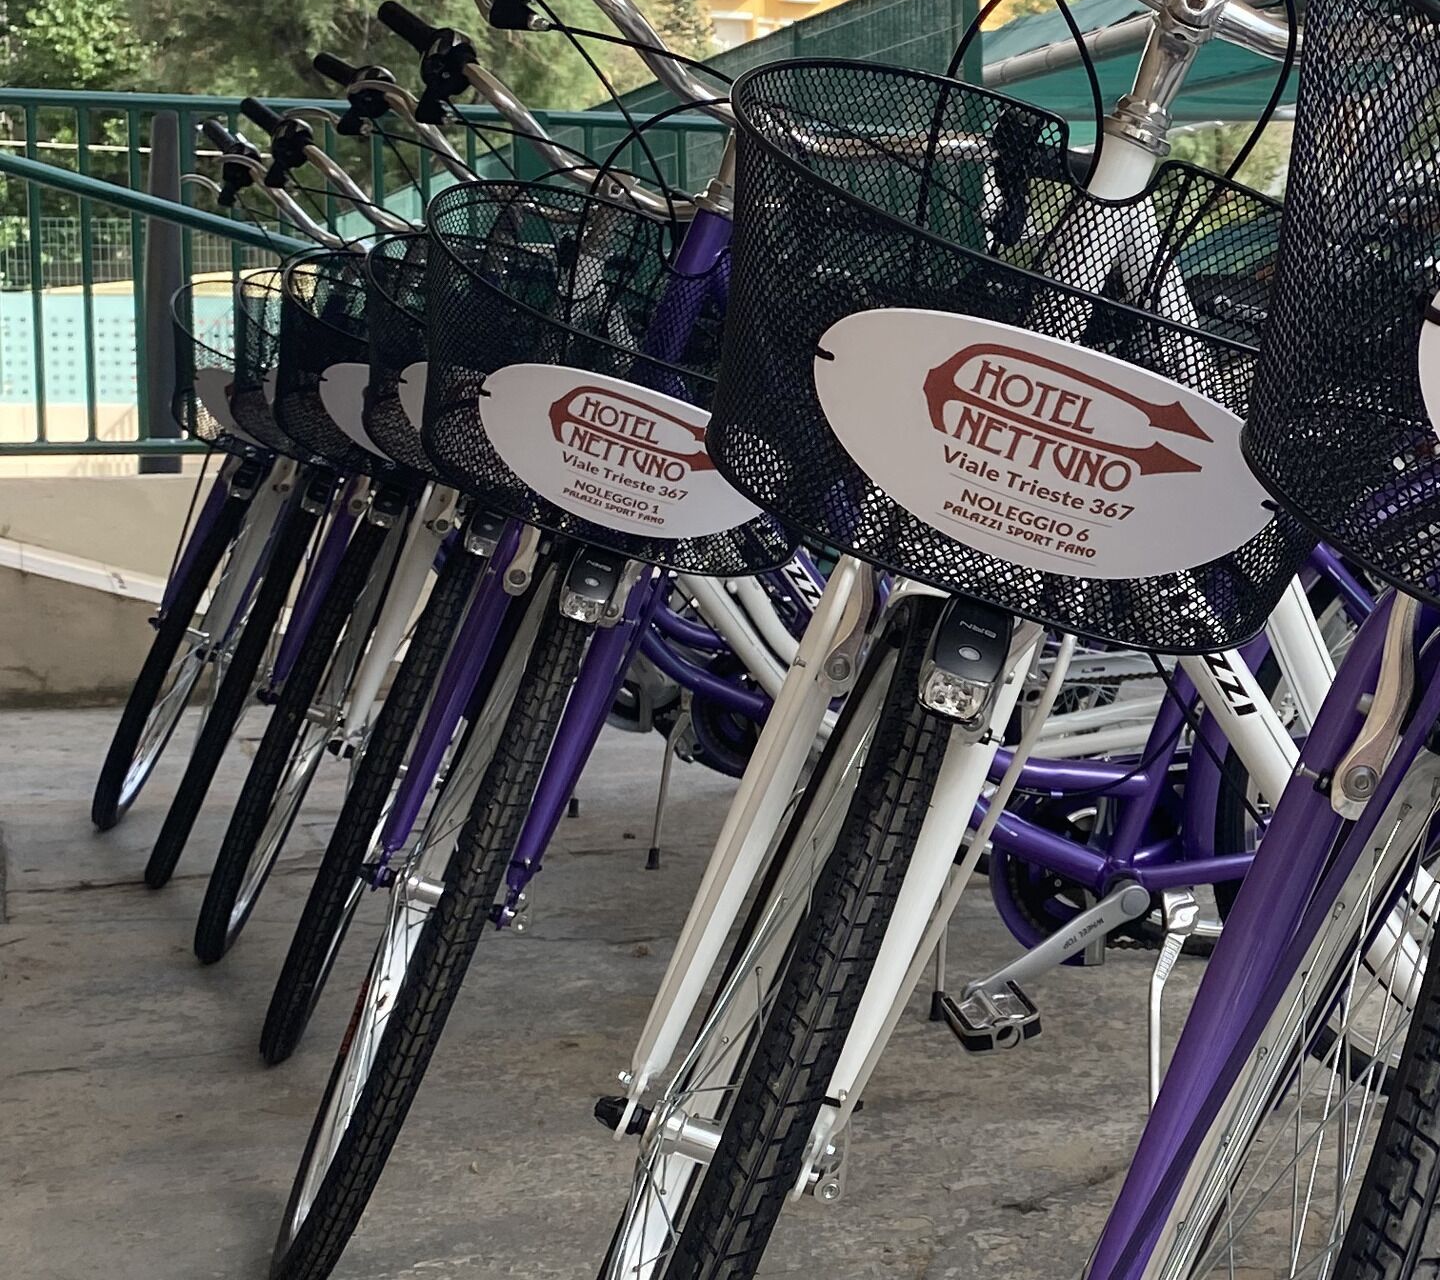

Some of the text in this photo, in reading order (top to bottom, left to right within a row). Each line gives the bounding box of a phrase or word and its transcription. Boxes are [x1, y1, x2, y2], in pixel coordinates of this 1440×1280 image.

[577, 396, 660, 445] HOTEL
[969, 359, 1095, 435] HOTEL
[562, 450, 689, 501] Viale Trieste 367
[567, 426, 685, 482] NETTUNO
[951, 406, 1132, 492] NETTUNO
[562, 487, 665, 525] PALAZZI SPORT FANO
[574, 479, 659, 515] NOLEGGIO 1
[944, 444, 1135, 521] Viale Trieste 367
[943, 500, 1097, 558] PALAZZI SPORT FANO
[960, 488, 1090, 542] NOLEGGIO 6
